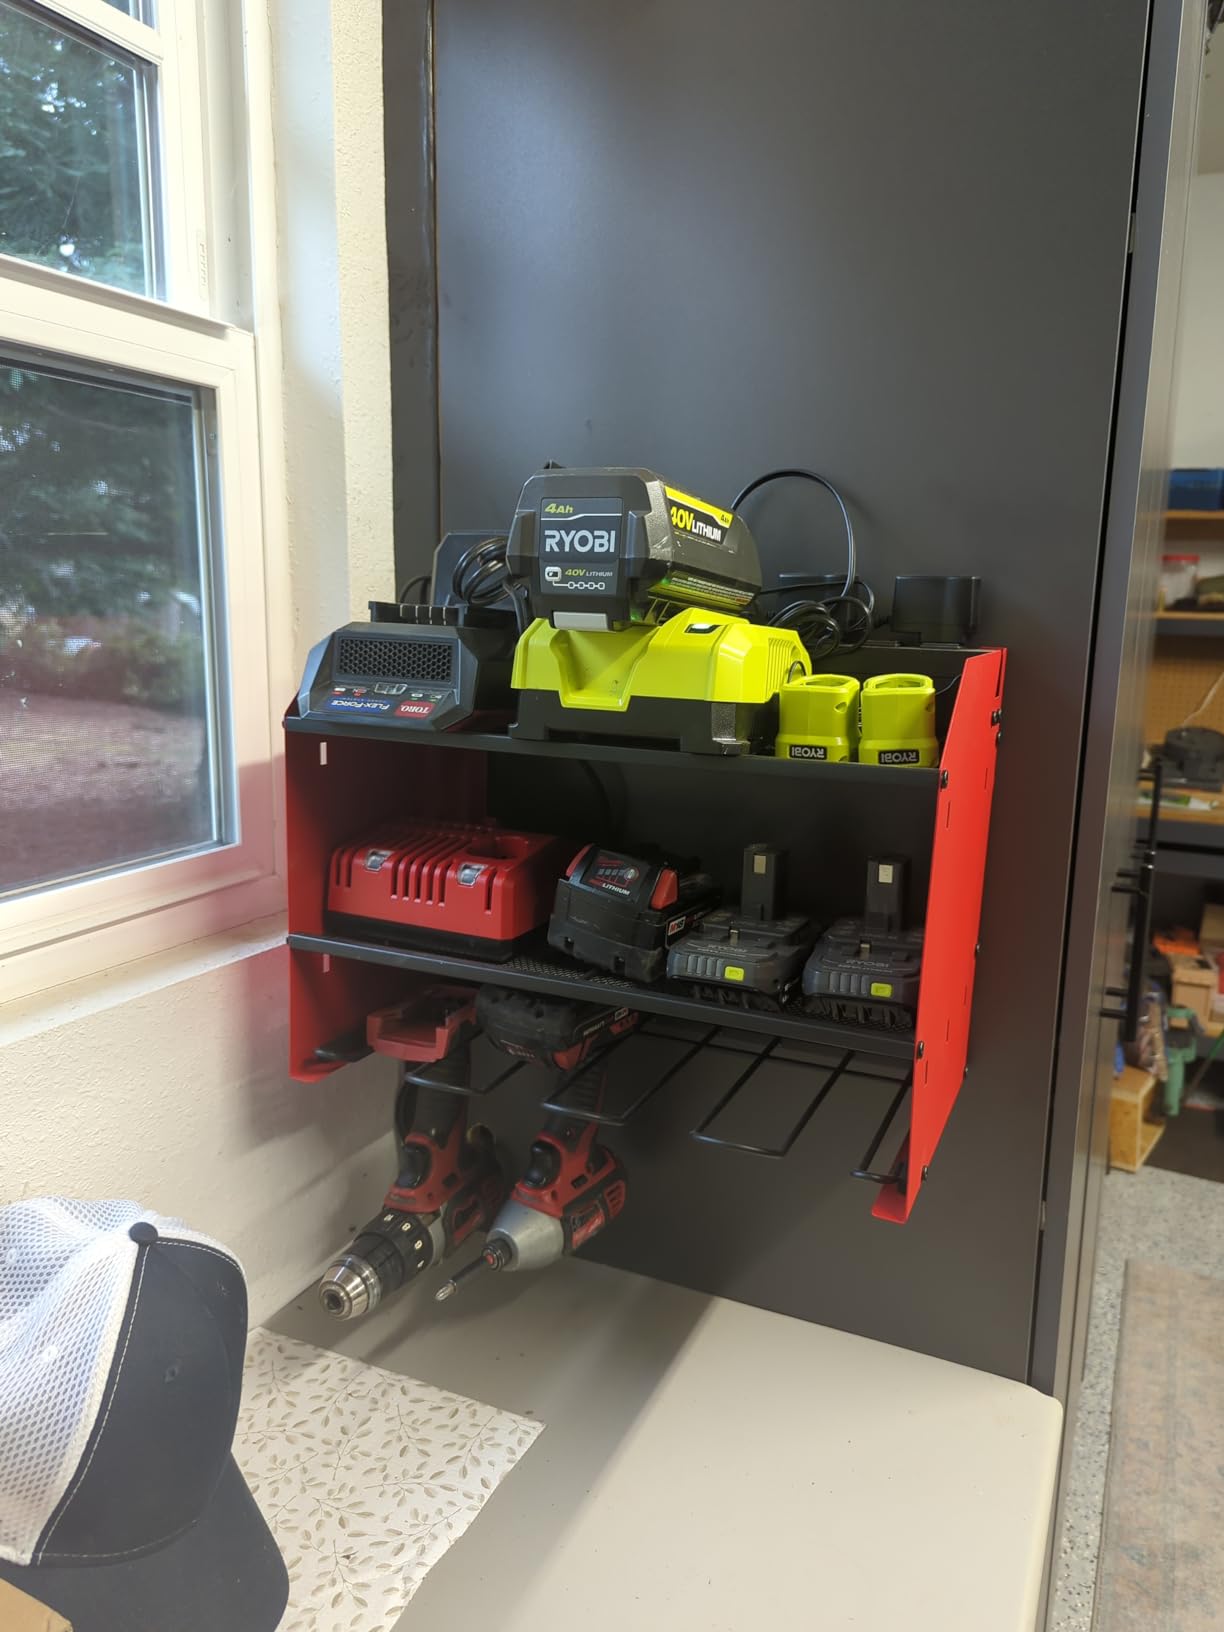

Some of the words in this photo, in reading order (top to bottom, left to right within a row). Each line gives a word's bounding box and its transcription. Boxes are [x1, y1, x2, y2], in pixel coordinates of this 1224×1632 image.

[544, 503, 573, 513] 4Ah
[671, 506, 694, 531] 40V
[692, 519, 722, 542] LITHIUM
[544, 530, 616, 552] RYOBI
[565, 568, 586, 577] 40V
[400, 704, 432, 715] TORO
[791, 746, 825, 759] RYOBI
[880, 752, 917, 763] RYOBI
[602, 882, 630, 896] LITHIUM
